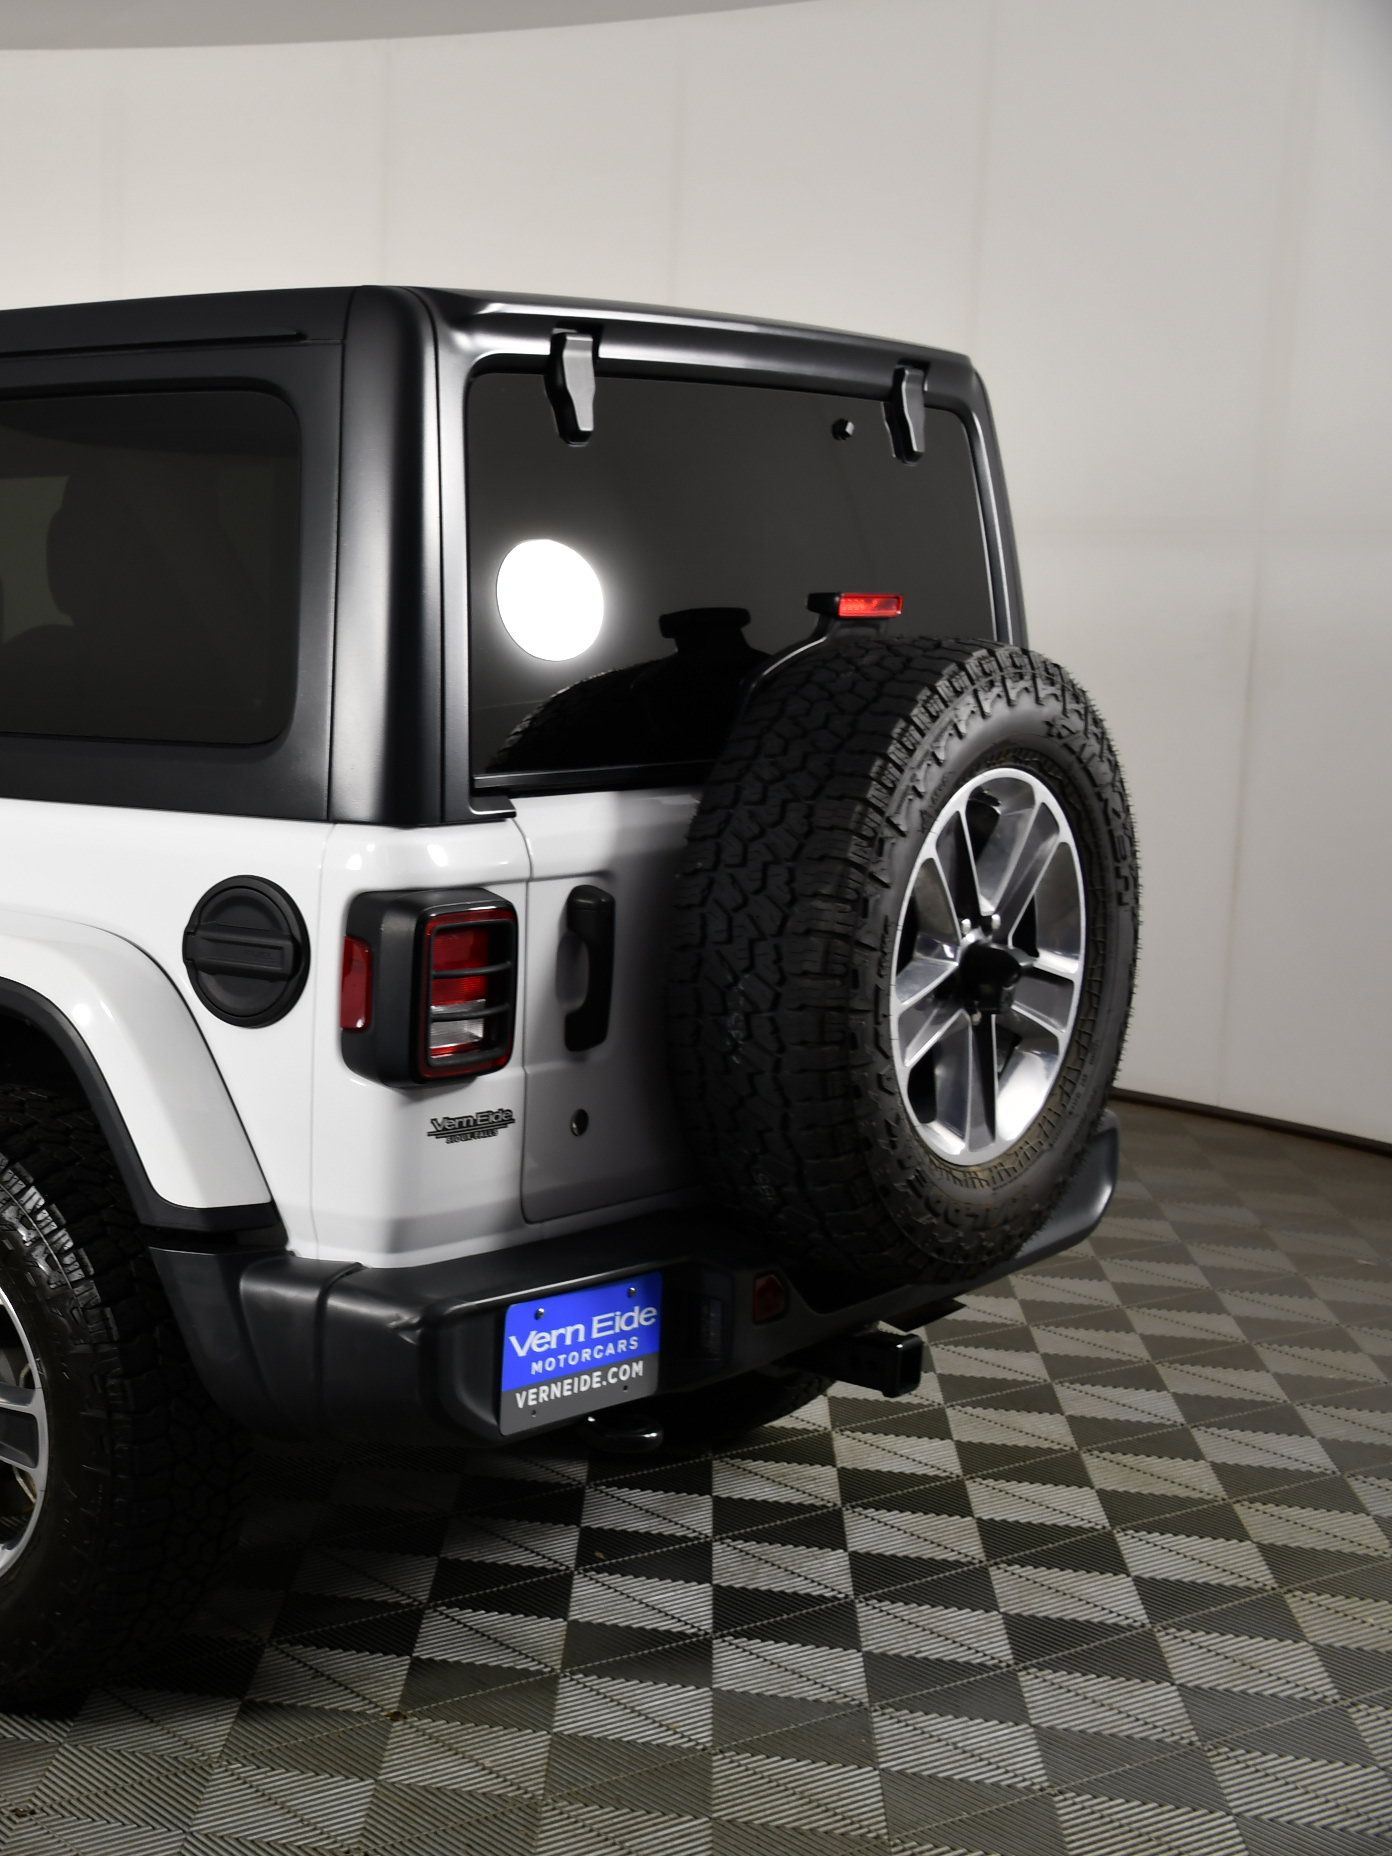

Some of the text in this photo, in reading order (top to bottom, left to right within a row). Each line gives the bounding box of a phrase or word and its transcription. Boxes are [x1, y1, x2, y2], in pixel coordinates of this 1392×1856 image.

[430, 1108, 513, 1132] Vern Eide
[508, 1305, 657, 1357] Vern Eide
[530, 1336, 639, 1375] MOTORCARS
[515, 1360, 644, 1409] VERNEIDE.COM
